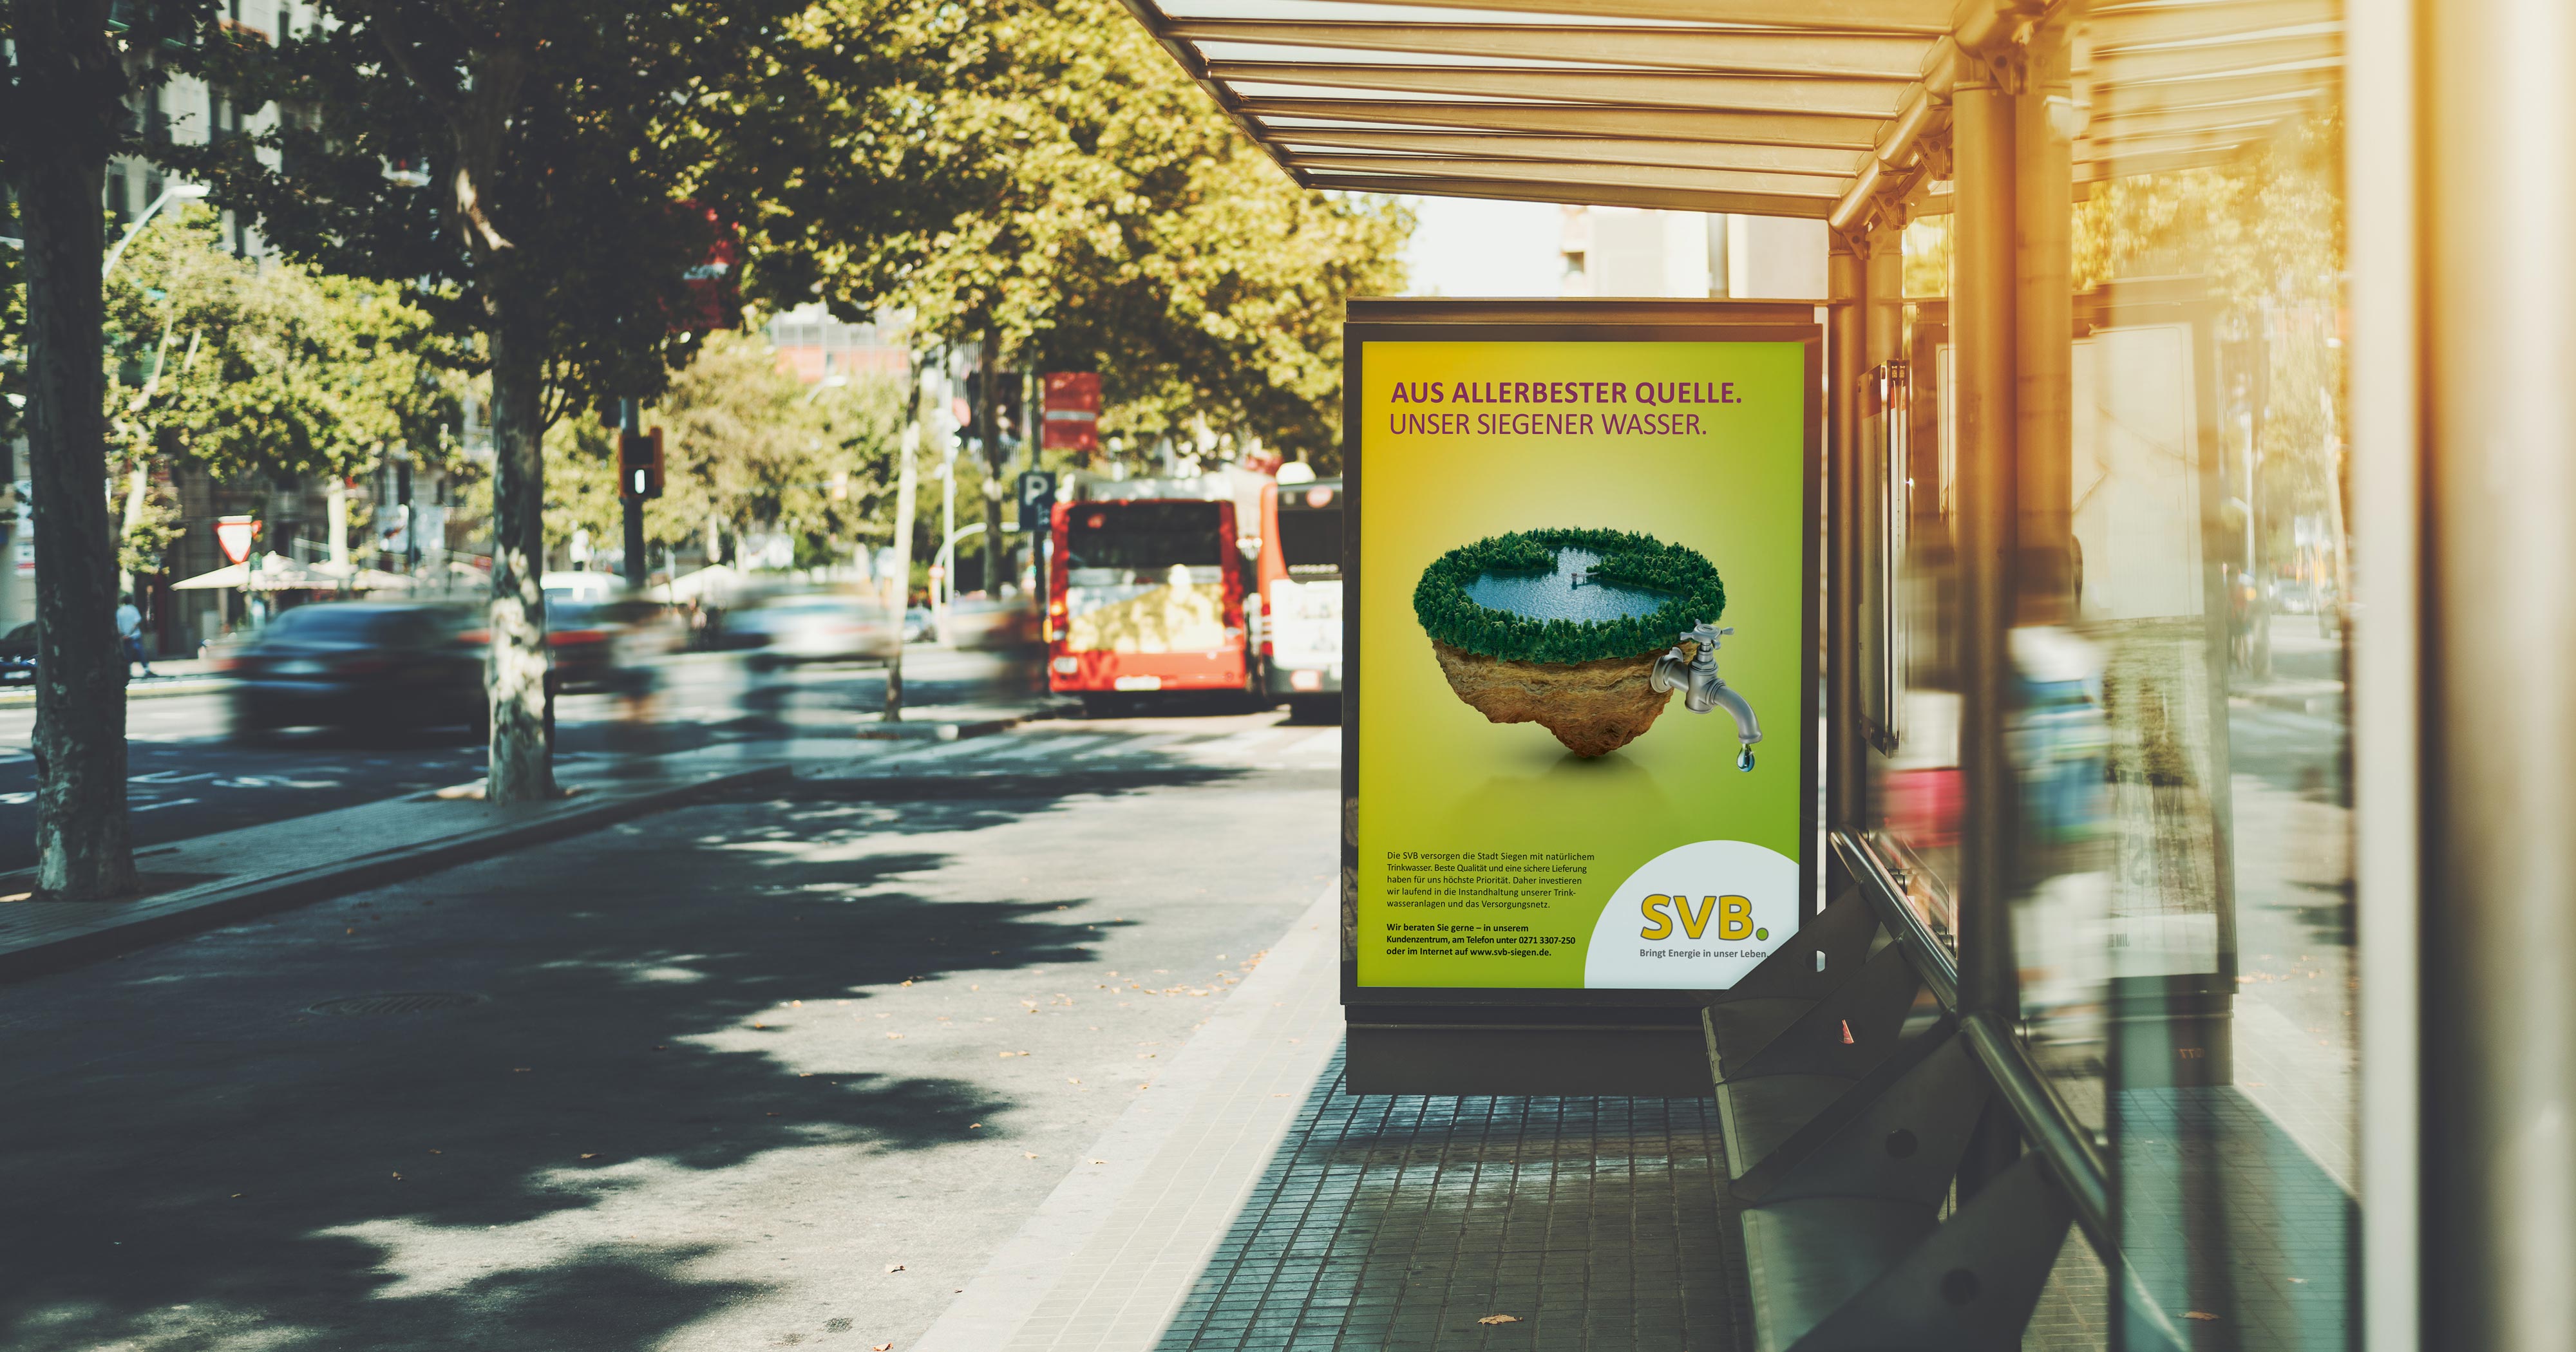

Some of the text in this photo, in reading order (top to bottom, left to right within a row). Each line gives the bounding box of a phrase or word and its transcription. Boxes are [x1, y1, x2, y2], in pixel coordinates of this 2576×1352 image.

[1391, 382, 1741, 406] AUS ALLERBESTER QUELLE.
[1390, 413, 1707, 435] UNSER SIEGENER WASSER.
[1025, 475, 1048, 505] P
[1501, 852, 1528, 861] Siegen
[1546, 852, 1595, 861] natürlichem
[1387, 863, 1432, 872] Trinkwasser.
[1457, 864, 1487, 872] Qualität
[1523, 864, 1550, 872] sichere
[1552, 865, 1587, 874] Lieferung
[1402, 887, 1432, 896] laufend
[1459, 888, 1519, 897] Instandhaltung
[1387, 899, 1550, 910] wasseranlagen und das Versorgungsnetz.
[1387, 935, 1450, 944] Kundenzentrum,
[1466, 935, 1494, 944] Telefon
[1470, 948, 1551, 957] www.svb-siegen.de.
[1640, 949, 1666, 959] Bringt
[1669, 949, 1701, 959] Energie
[1741, 950, 1769, 958] Leben.
